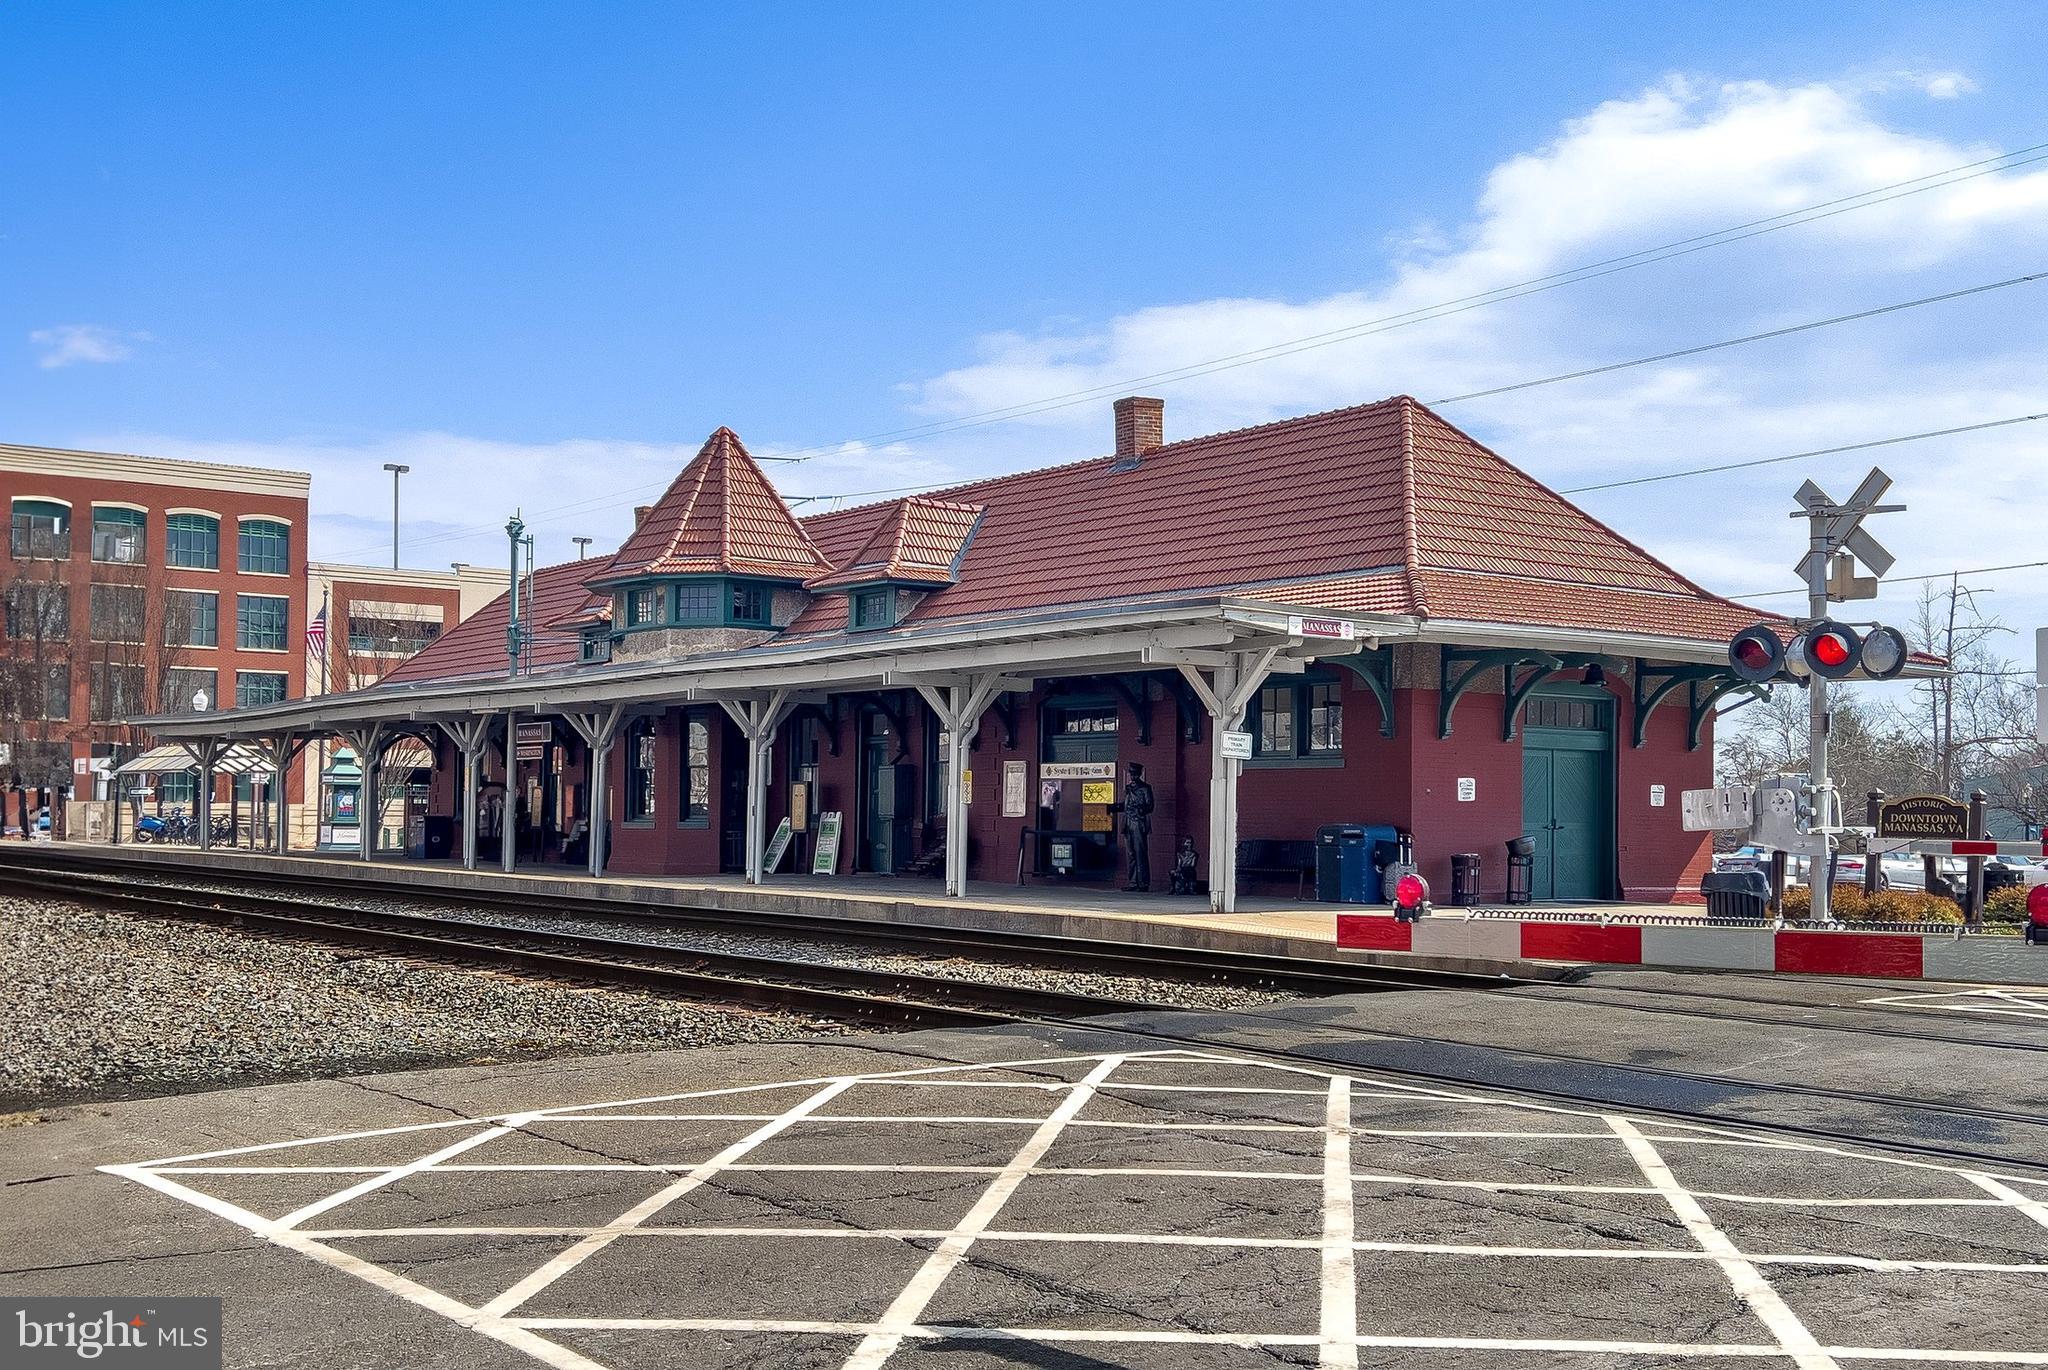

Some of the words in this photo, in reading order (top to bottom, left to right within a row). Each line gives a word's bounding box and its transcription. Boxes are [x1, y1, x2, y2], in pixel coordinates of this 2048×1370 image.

[1302, 621, 1342, 633] MANASSAS
[1901, 800, 1948, 811] HISTORIC
[1890, 813, 1958, 824] DOWNTOWN
[1884, 823, 1946, 834] MANASSAS,
[1948, 824, 1964, 833] VA
